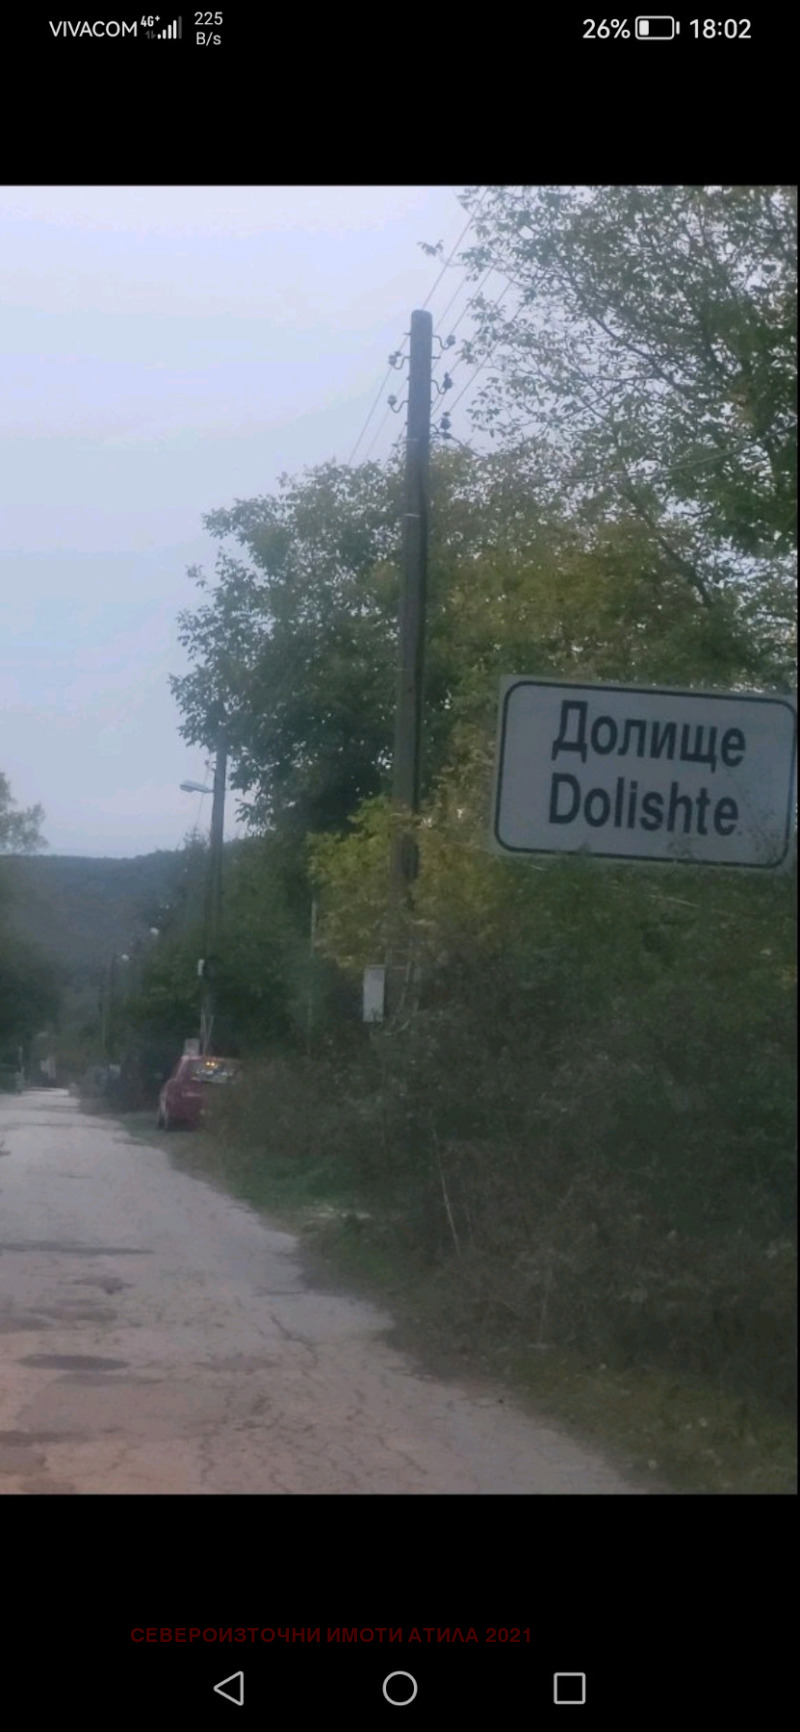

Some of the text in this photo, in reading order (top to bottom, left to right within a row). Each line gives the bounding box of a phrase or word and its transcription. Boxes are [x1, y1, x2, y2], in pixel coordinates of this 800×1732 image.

[194, 11, 223, 26] 225
[49, 21, 138, 38] VIVACOM
[195, 31, 222, 47] B/s
[582, 19, 631, 39] 26%
[689, 19, 752, 39] 18:02
[551, 699, 746, 773] Долище
[548, 771, 740, 836] Dolishte
